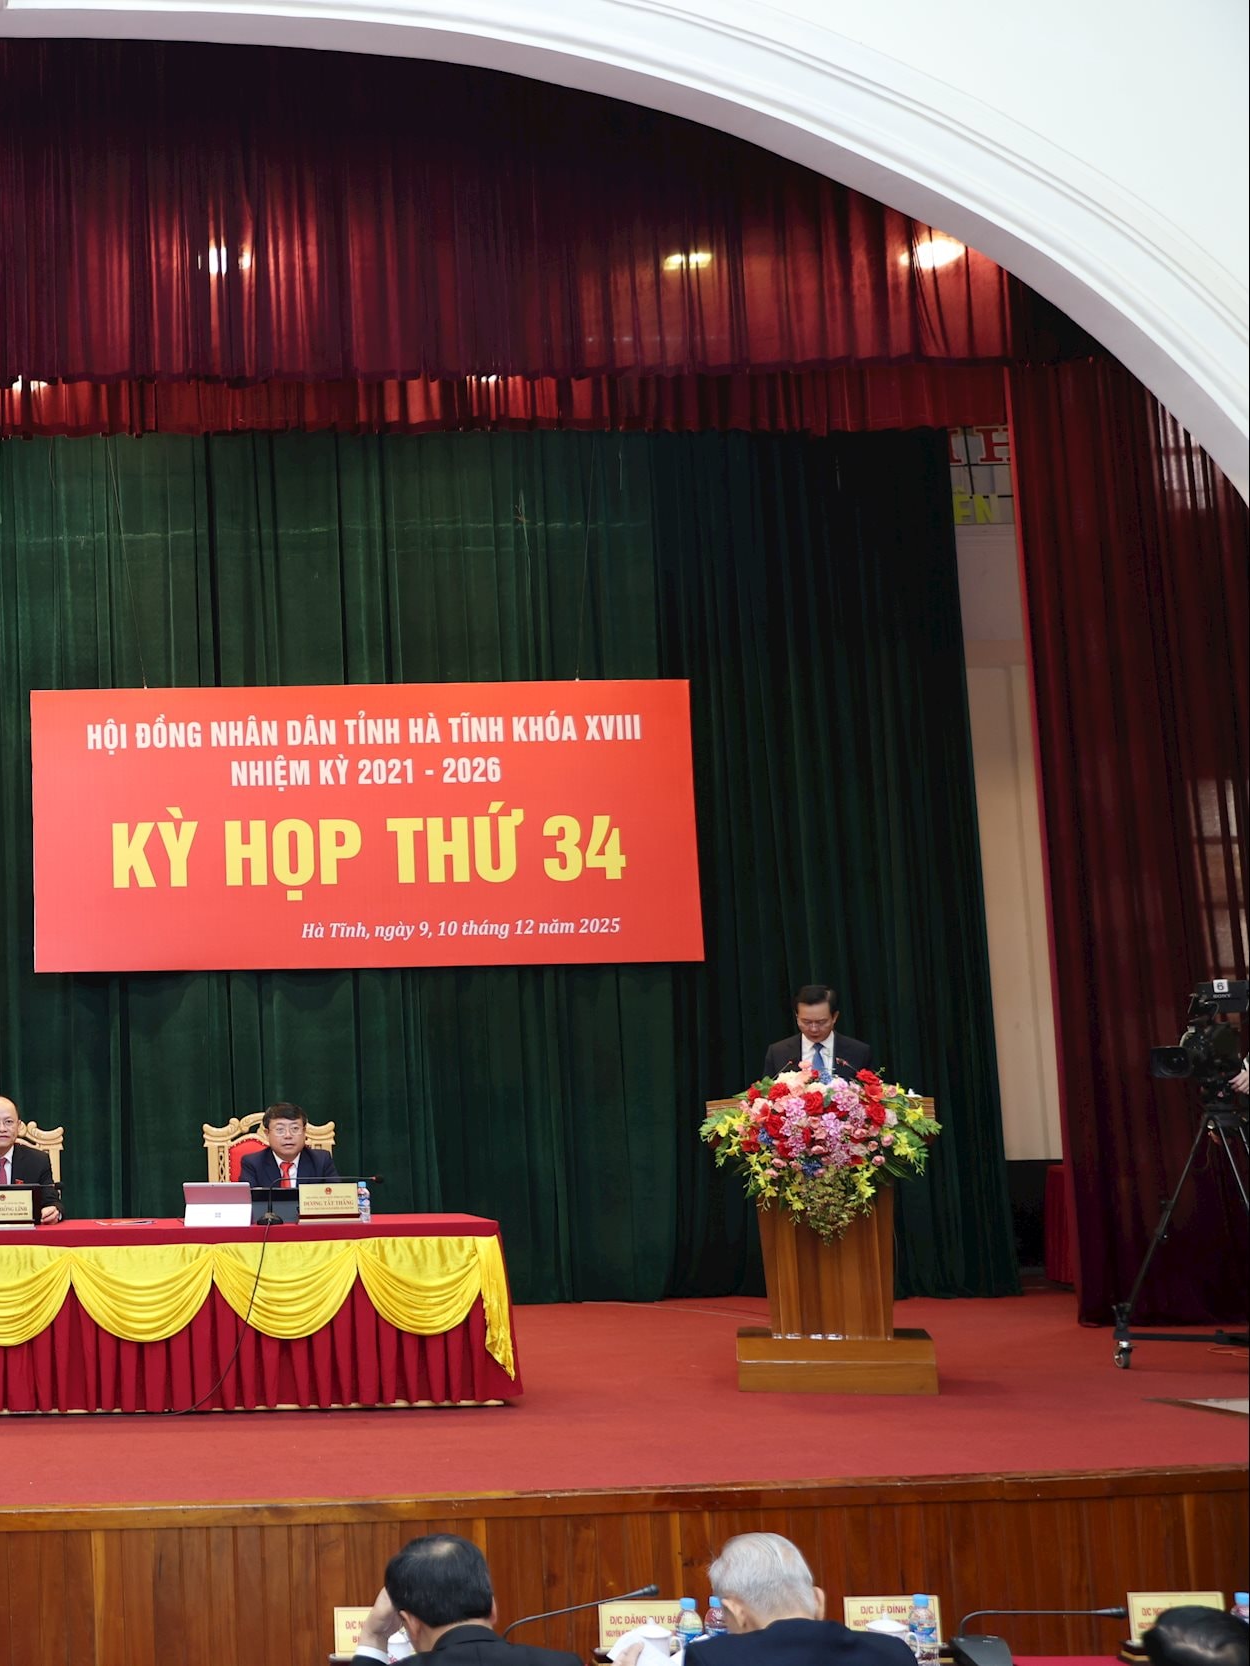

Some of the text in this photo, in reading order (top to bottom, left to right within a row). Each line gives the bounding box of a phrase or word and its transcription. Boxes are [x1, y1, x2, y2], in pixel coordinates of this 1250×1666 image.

[87, 711, 641, 755] HỘI ĐỒNG NHÂN DÂN TỈNH HÀ TĨNH KHÓA XVIII
[231, 757, 311, 792] NHIỆM
[319, 754, 350, 786] KỲ
[358, 758, 413, 785] 2021
[443, 757, 502, 784] 2026
[111, 801, 627, 901] KỲ HỌP THỨ 34
[301, 917, 621, 941] Hà Tĩnh, ngày 9, 10 tháng 12 năm 2025
